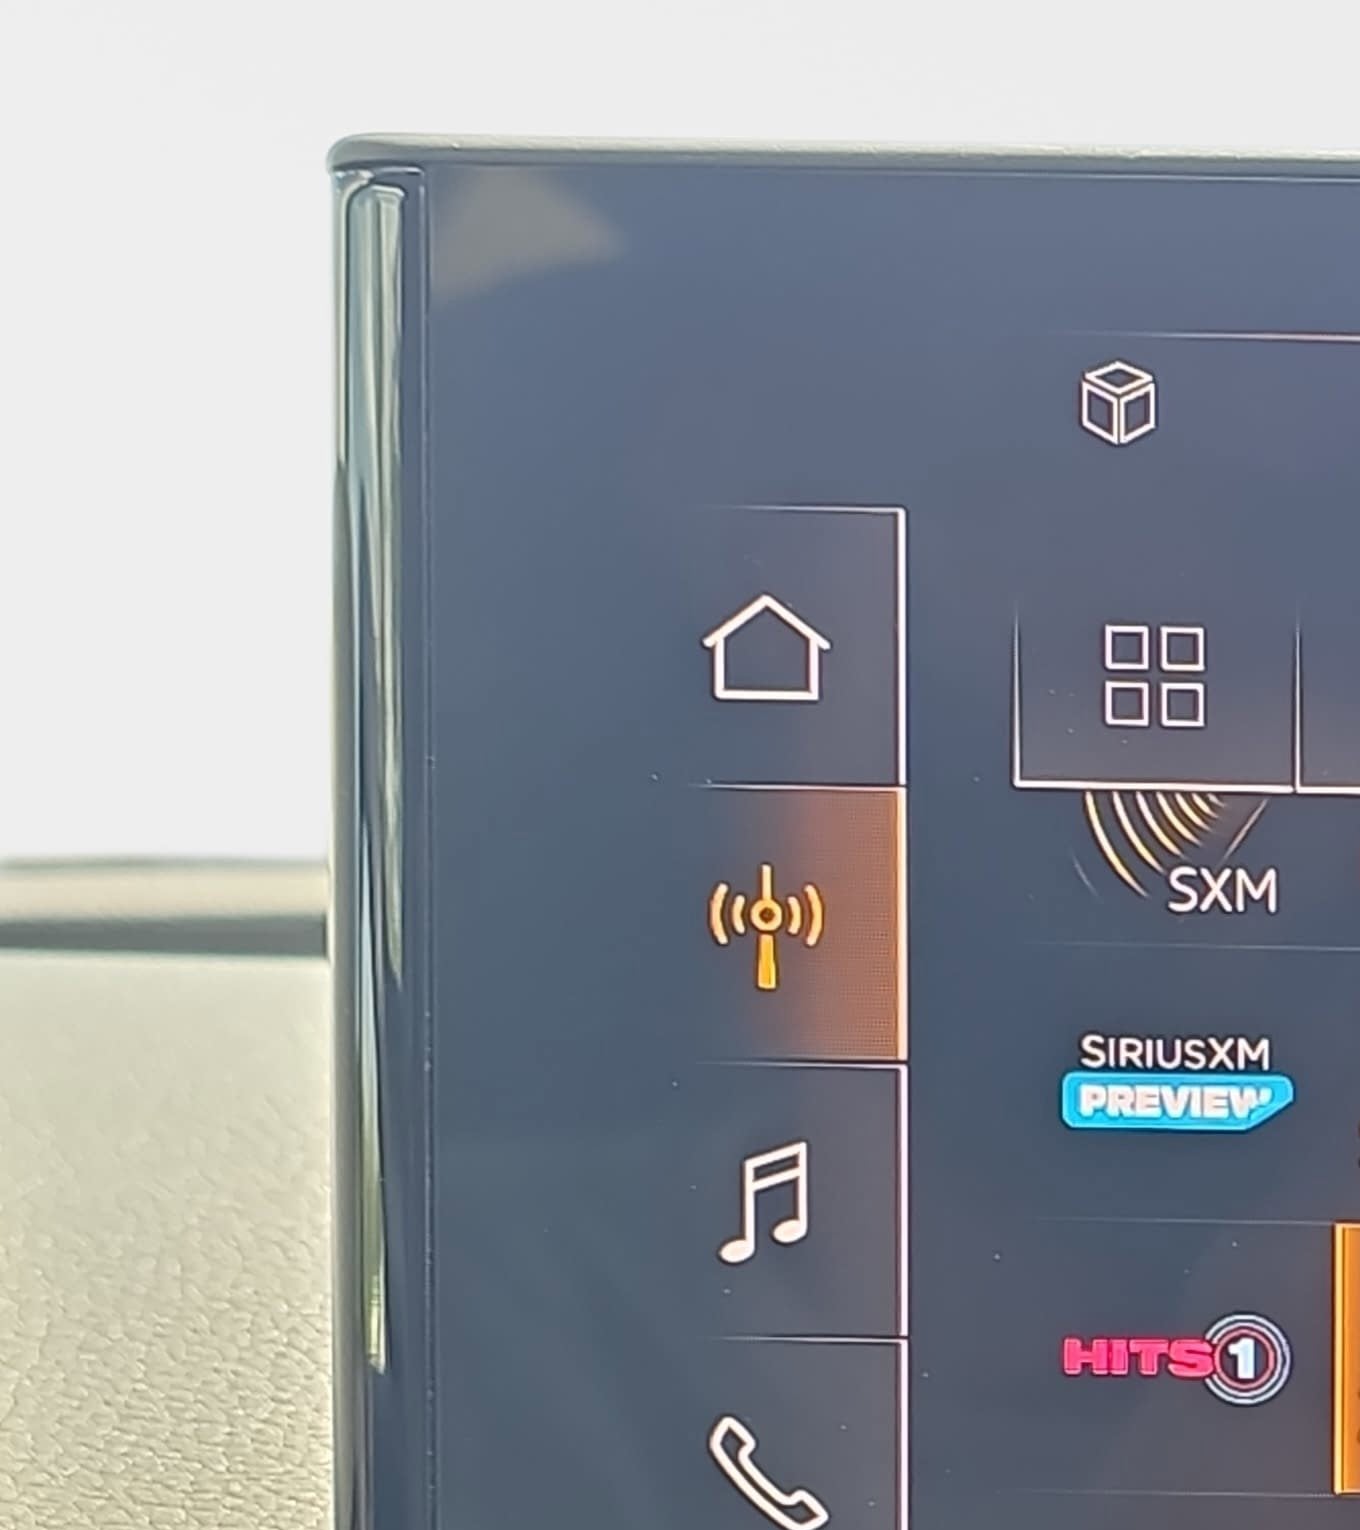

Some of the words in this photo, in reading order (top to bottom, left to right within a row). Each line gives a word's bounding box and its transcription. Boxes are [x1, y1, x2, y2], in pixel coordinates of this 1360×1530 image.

[1166, 866, 1278, 914] SXM
[1080, 1034, 1270, 1071] SIRIUSXM
[1080, 1084, 1272, 1119] PREVIEW
[1062, 1337, 1214, 1377] HITS
[1228, 1340, 1256, 1380] 1
